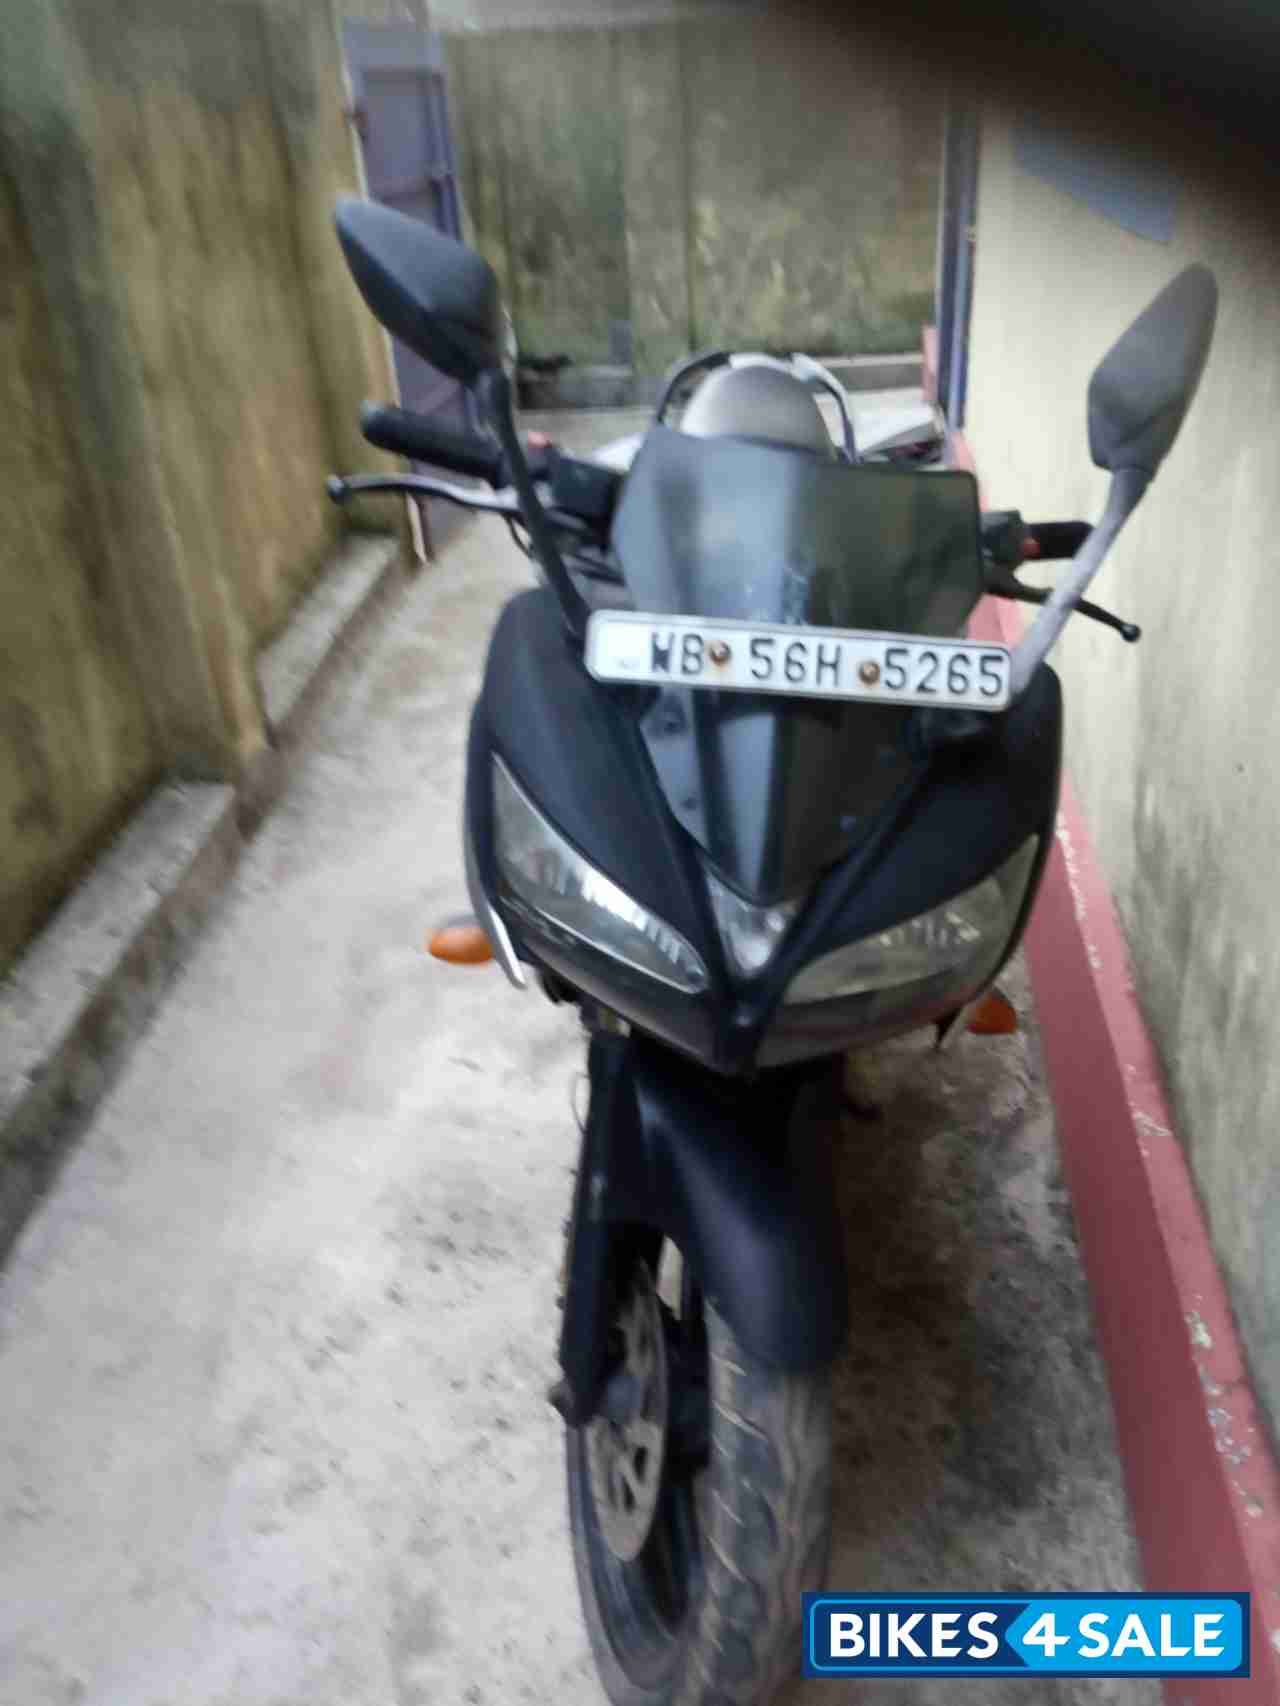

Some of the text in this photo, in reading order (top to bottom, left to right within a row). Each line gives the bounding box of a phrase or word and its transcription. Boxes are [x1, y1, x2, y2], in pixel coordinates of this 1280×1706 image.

[651, 632, 1004, 697] WB 56H 5265
